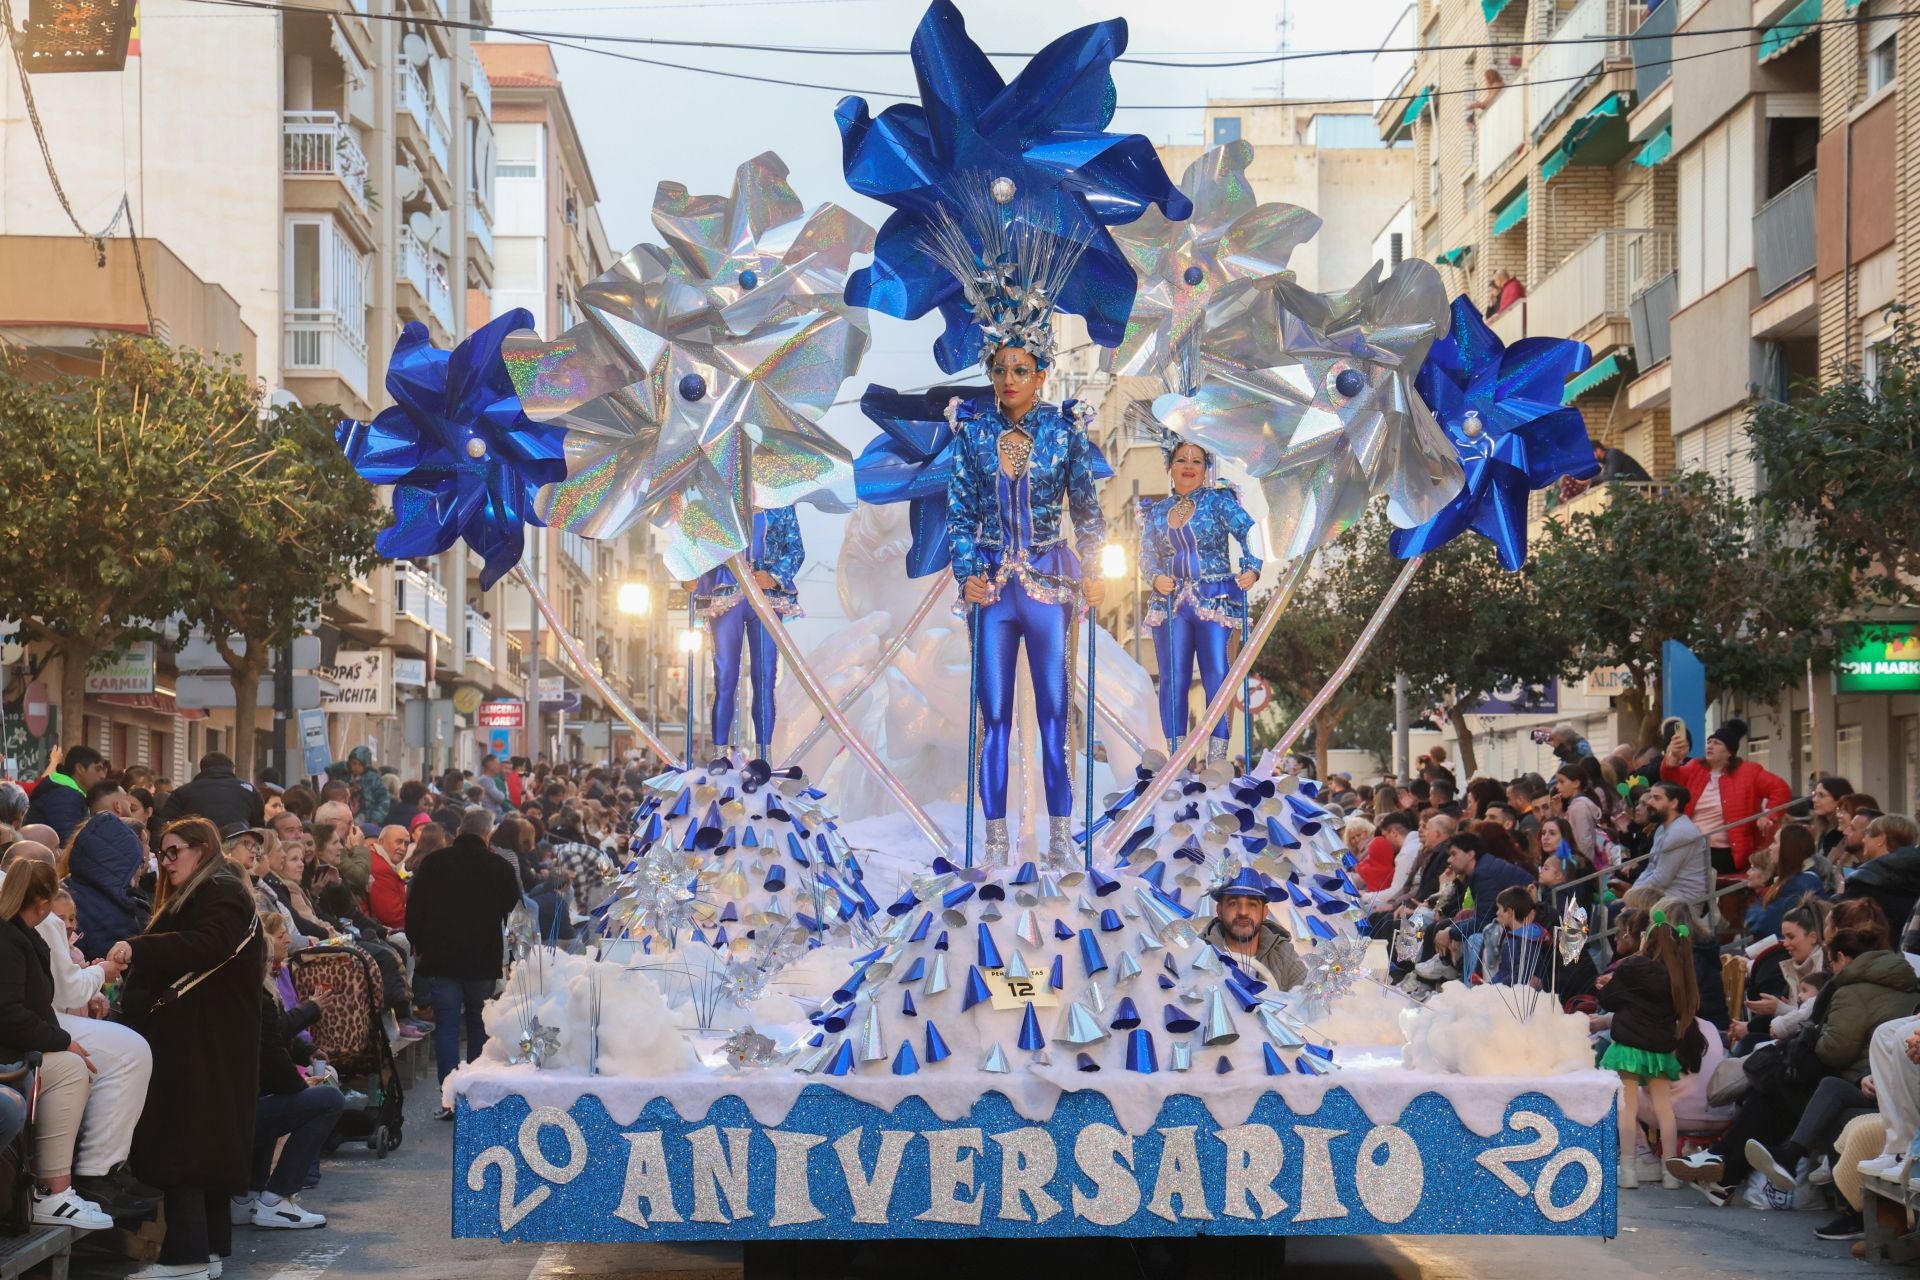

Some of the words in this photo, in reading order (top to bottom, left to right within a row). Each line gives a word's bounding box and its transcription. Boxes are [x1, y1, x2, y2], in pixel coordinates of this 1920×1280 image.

[331, 665, 362, 680] OPAS
[1875, 661, 1920, 675] MARK
[90, 676, 148, 690] CARMEN
[328, 688, 377, 703] NCHITA
[1008, 982, 1035, 997] 12
[467, 1106, 588, 1232] 20
[613, 1123, 1424, 1228] ANIVERSARIO
[1476, 1111, 1603, 1222] 20
